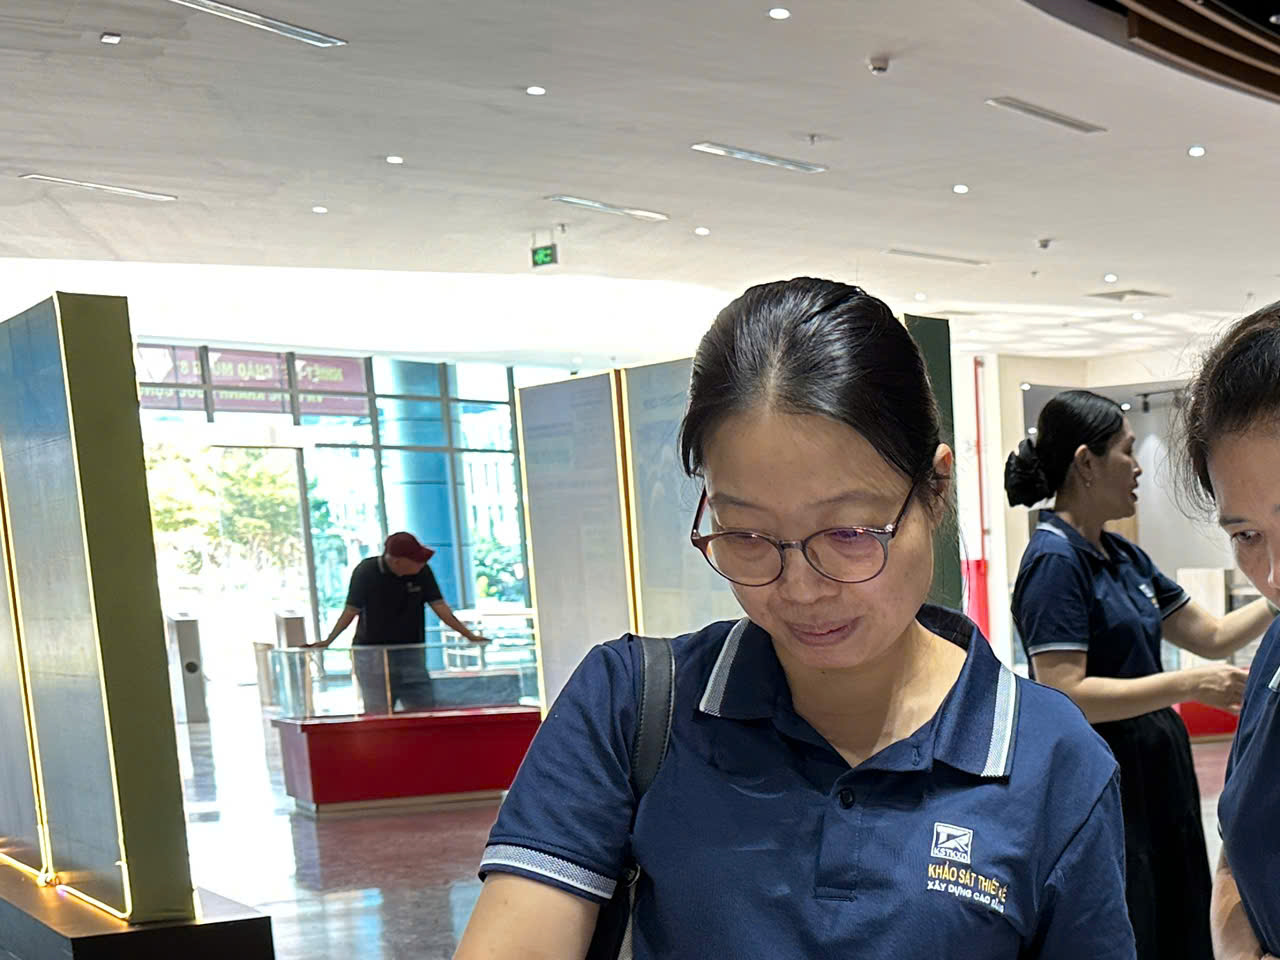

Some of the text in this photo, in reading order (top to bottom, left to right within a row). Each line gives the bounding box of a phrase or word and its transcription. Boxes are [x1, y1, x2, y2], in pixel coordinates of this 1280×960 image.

[928, 861, 957, 881] KHẢO
[958, 868, 976, 887] SÁT
[978, 873, 1000, 894] THIẾT
[927, 880, 946, 892] XÂY
[948, 885, 972, 898] DỰNG
[973, 891, 991, 905] CAO
